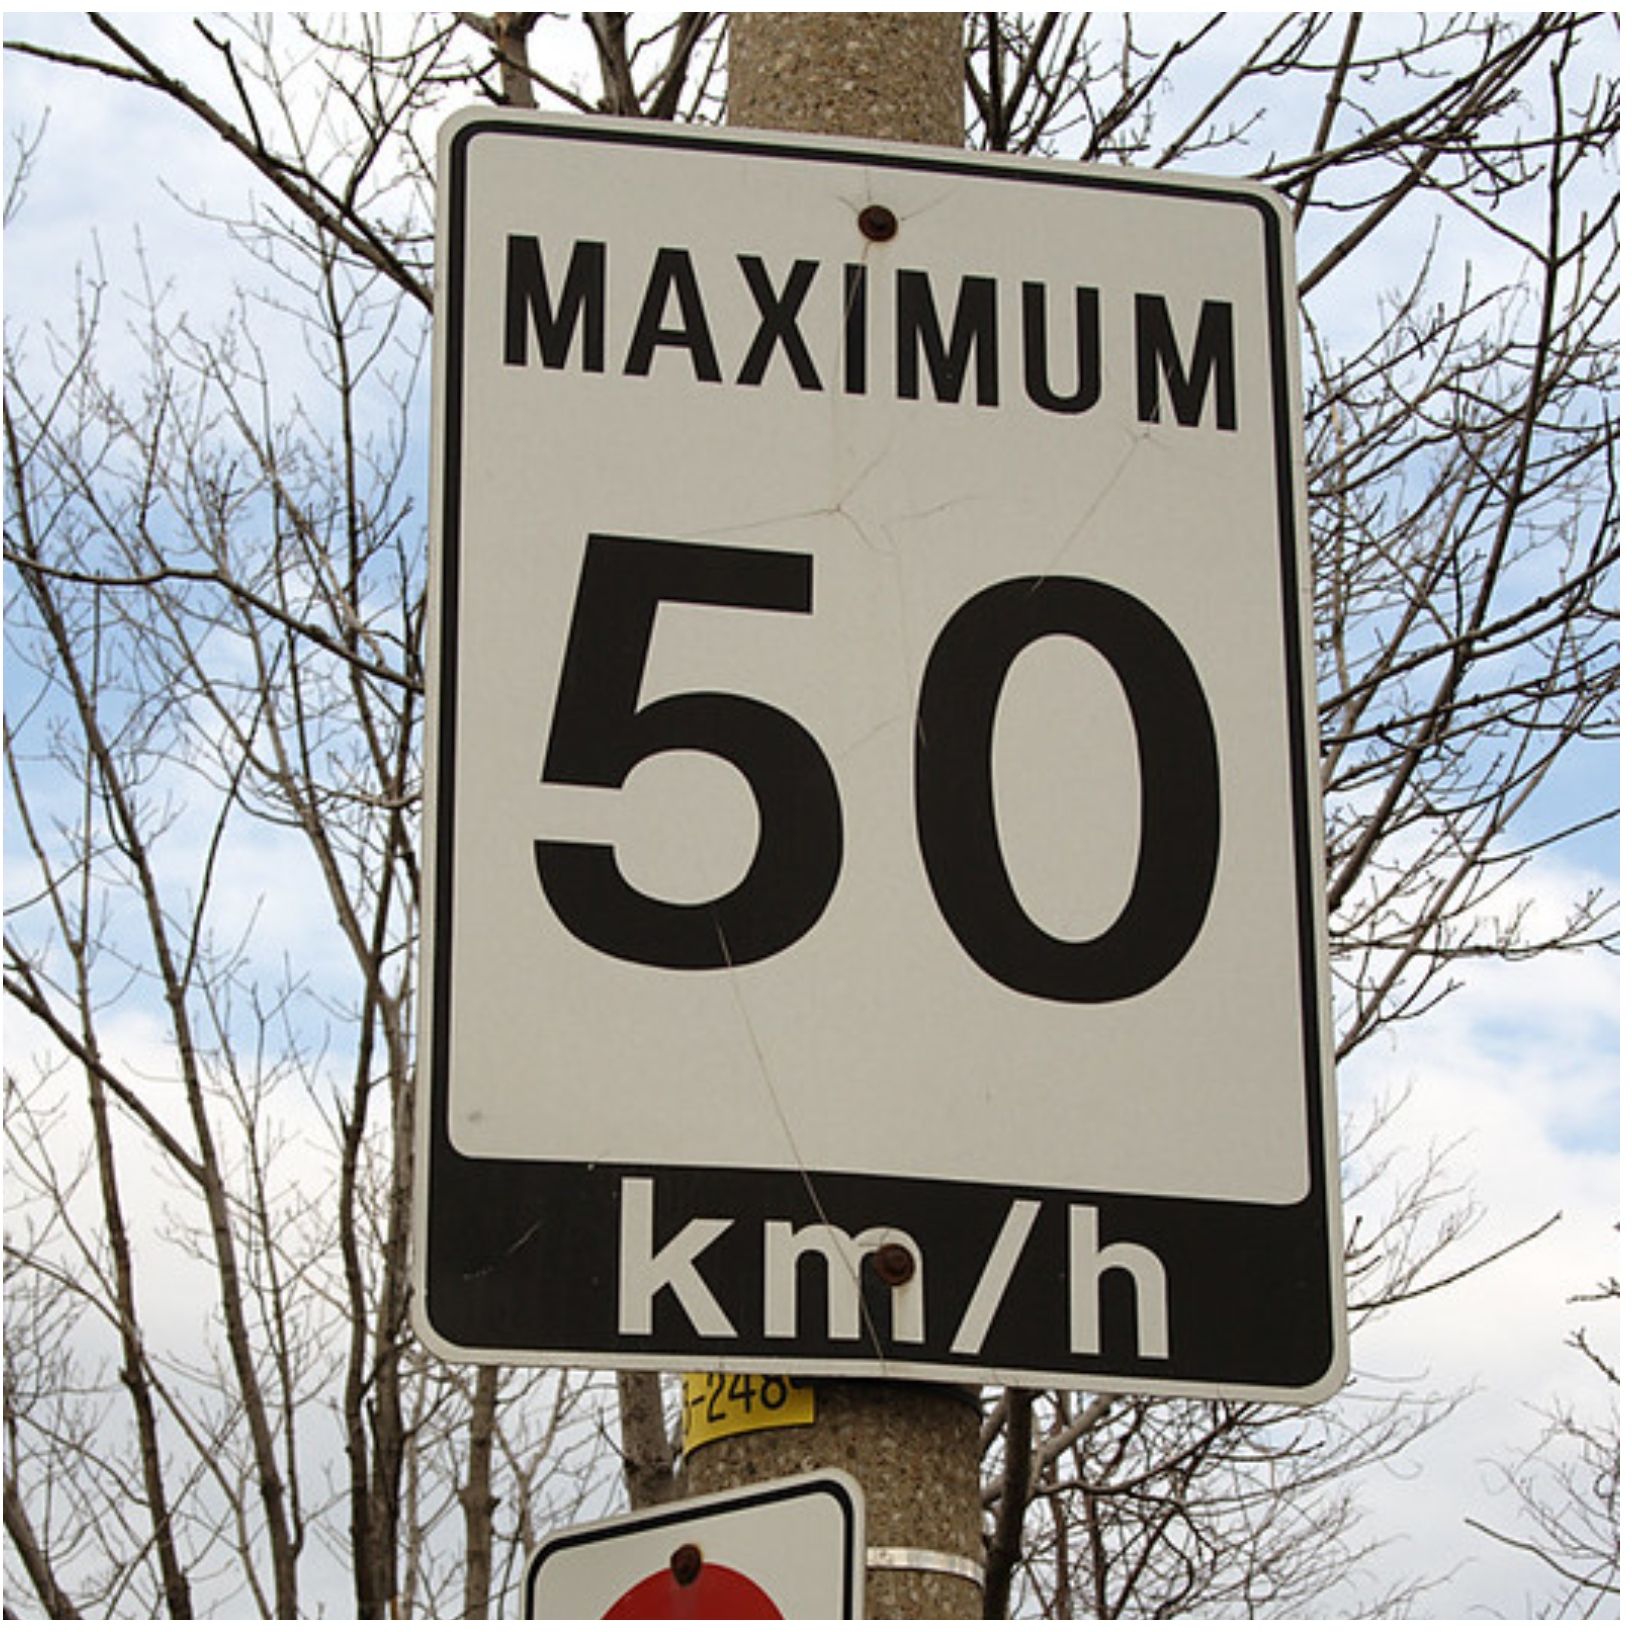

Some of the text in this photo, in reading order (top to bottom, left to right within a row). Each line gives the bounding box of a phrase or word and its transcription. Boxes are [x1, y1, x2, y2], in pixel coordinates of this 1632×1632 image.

[504, 235, 1238, 432] MAXIMUM
[534, 534, 1221, 1005] 50
[618, 1178, 1169, 1359] km/h
